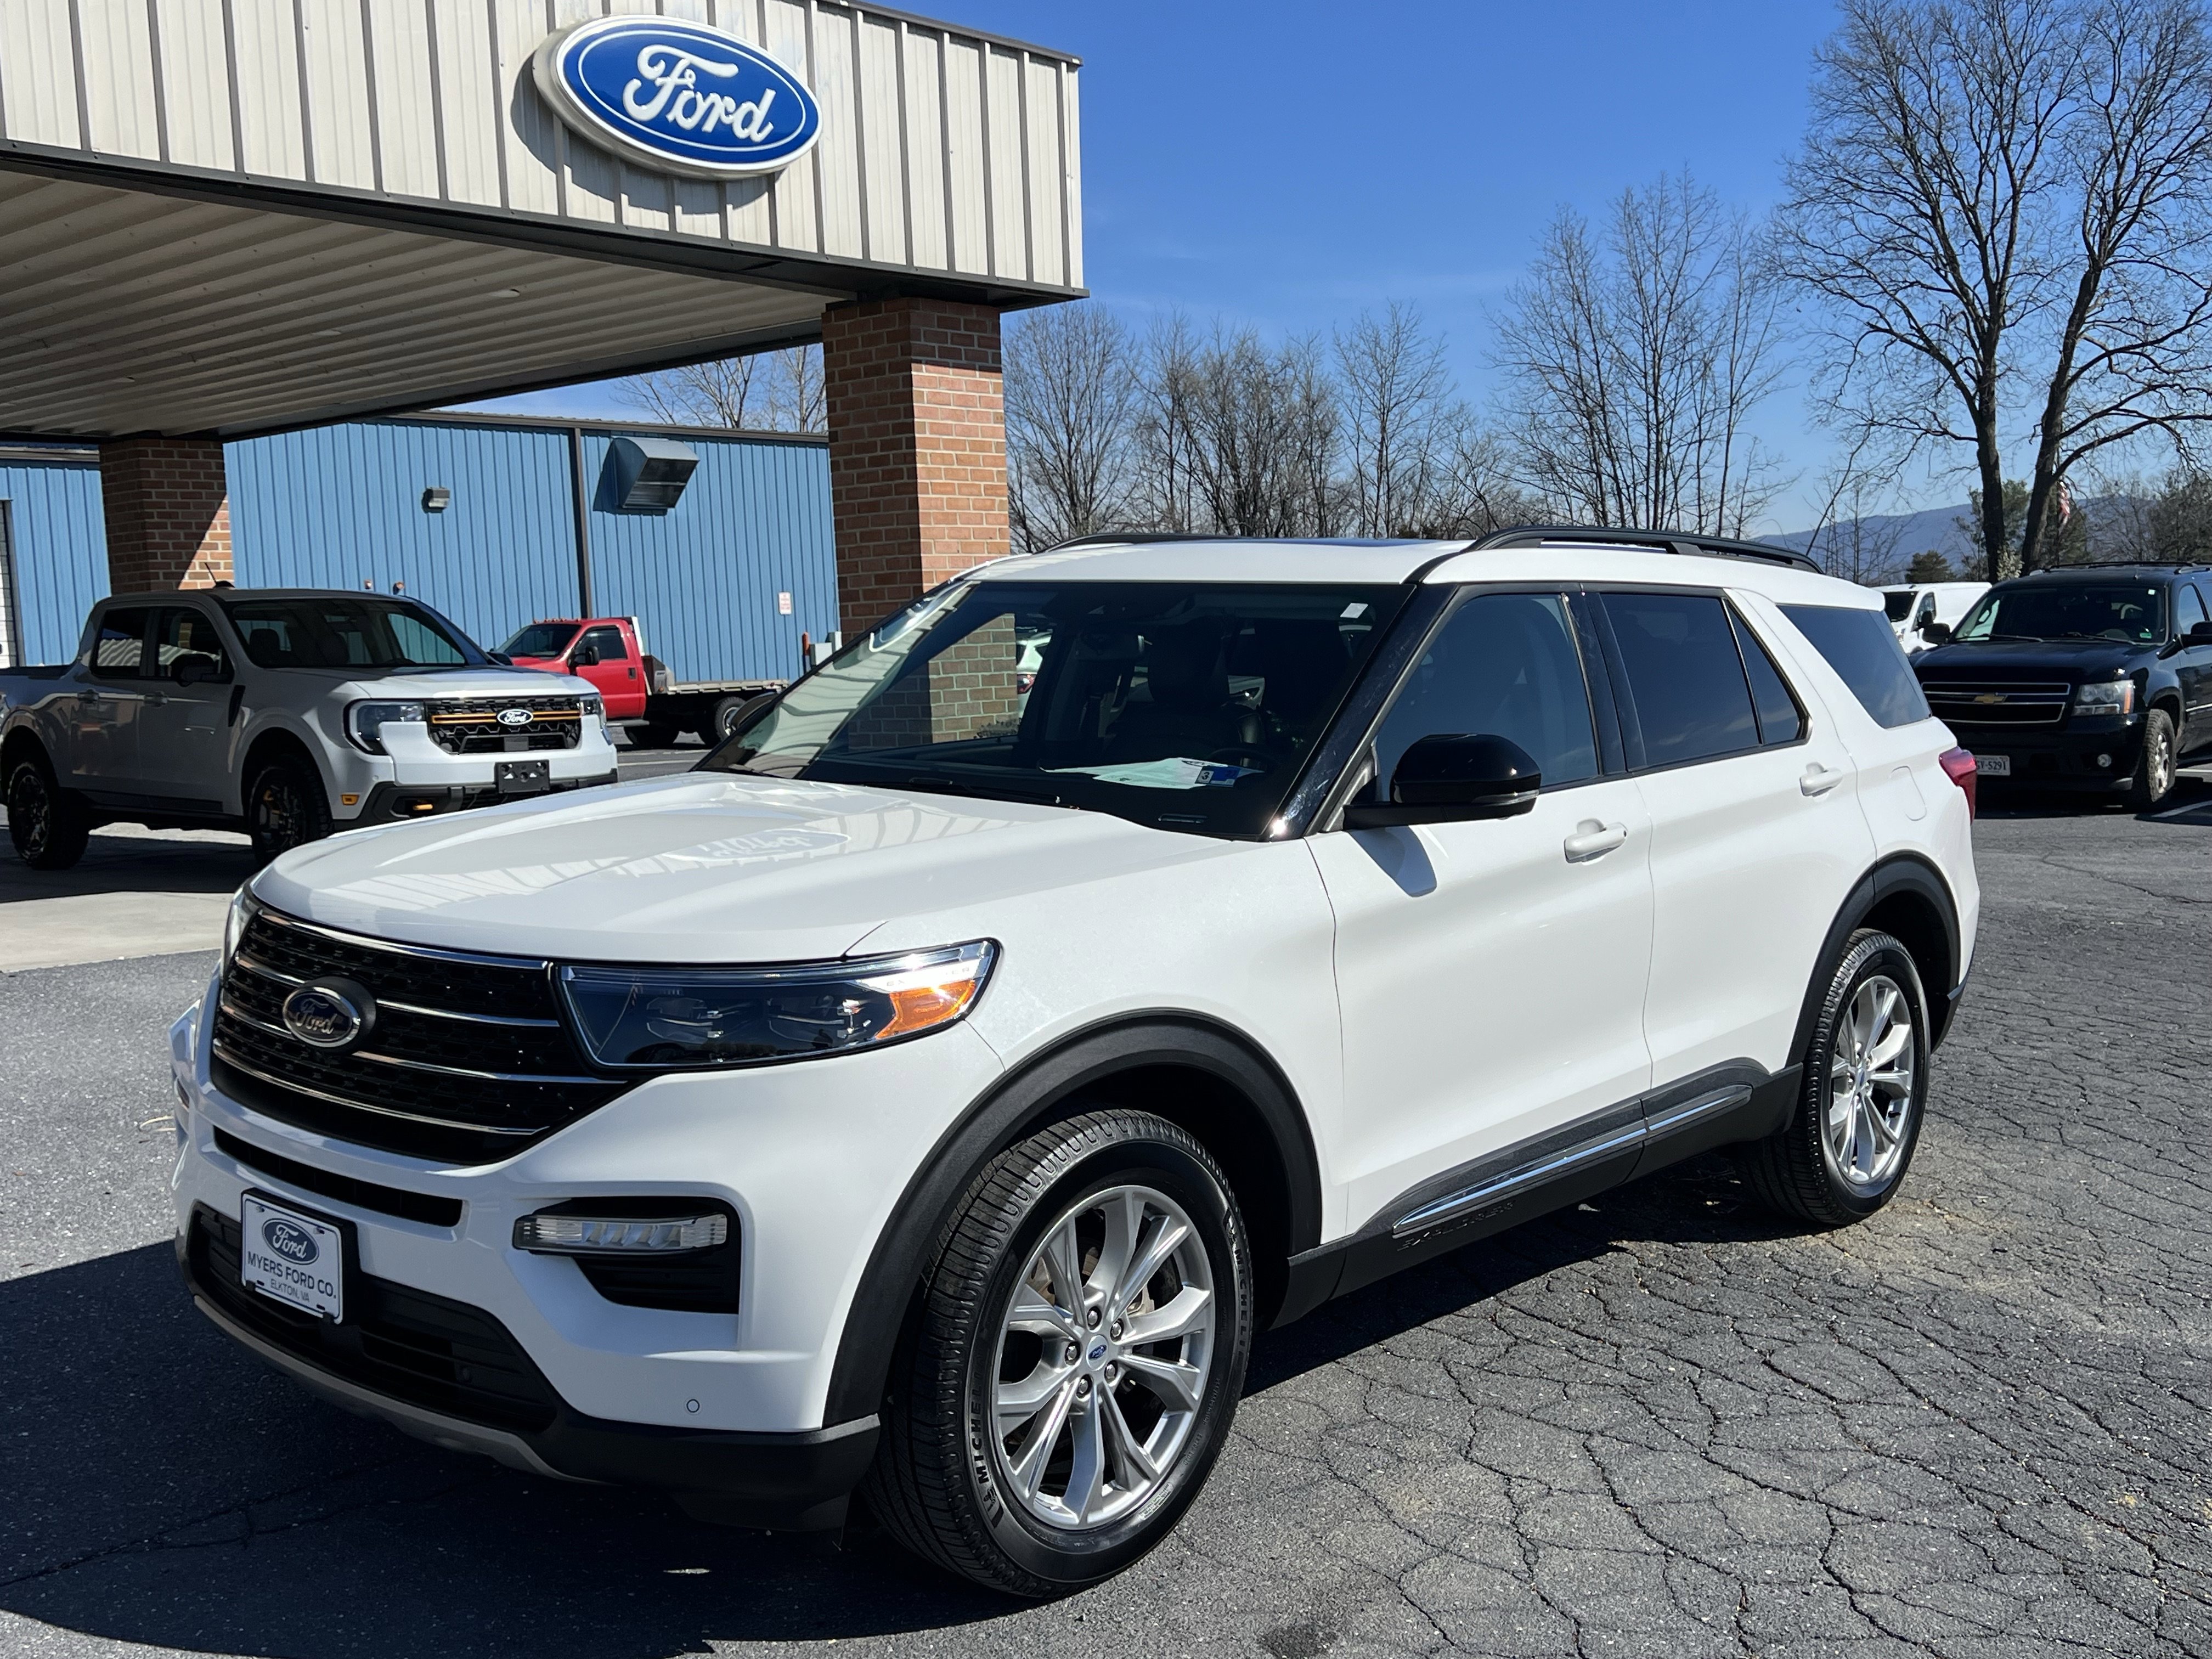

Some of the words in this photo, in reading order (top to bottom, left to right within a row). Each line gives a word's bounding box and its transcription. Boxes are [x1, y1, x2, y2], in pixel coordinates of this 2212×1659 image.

[623, 44, 776, 143] Ford
[504, 712, 527, 723] Ford
[1202, 771, 1210, 780] 3
[887, 967, 970, 987] EXER
[295, 997, 338, 1035] Ford
[273, 1224, 307, 1259] Ford
[247, 1251, 283, 1277] MYERS
[286, 1266, 315, 1290] FORD
[318, 1279, 337, 1299] CO.
[270, 1278, 300, 1300] ELKTON,
[301, 1291, 310, 1302] VA
